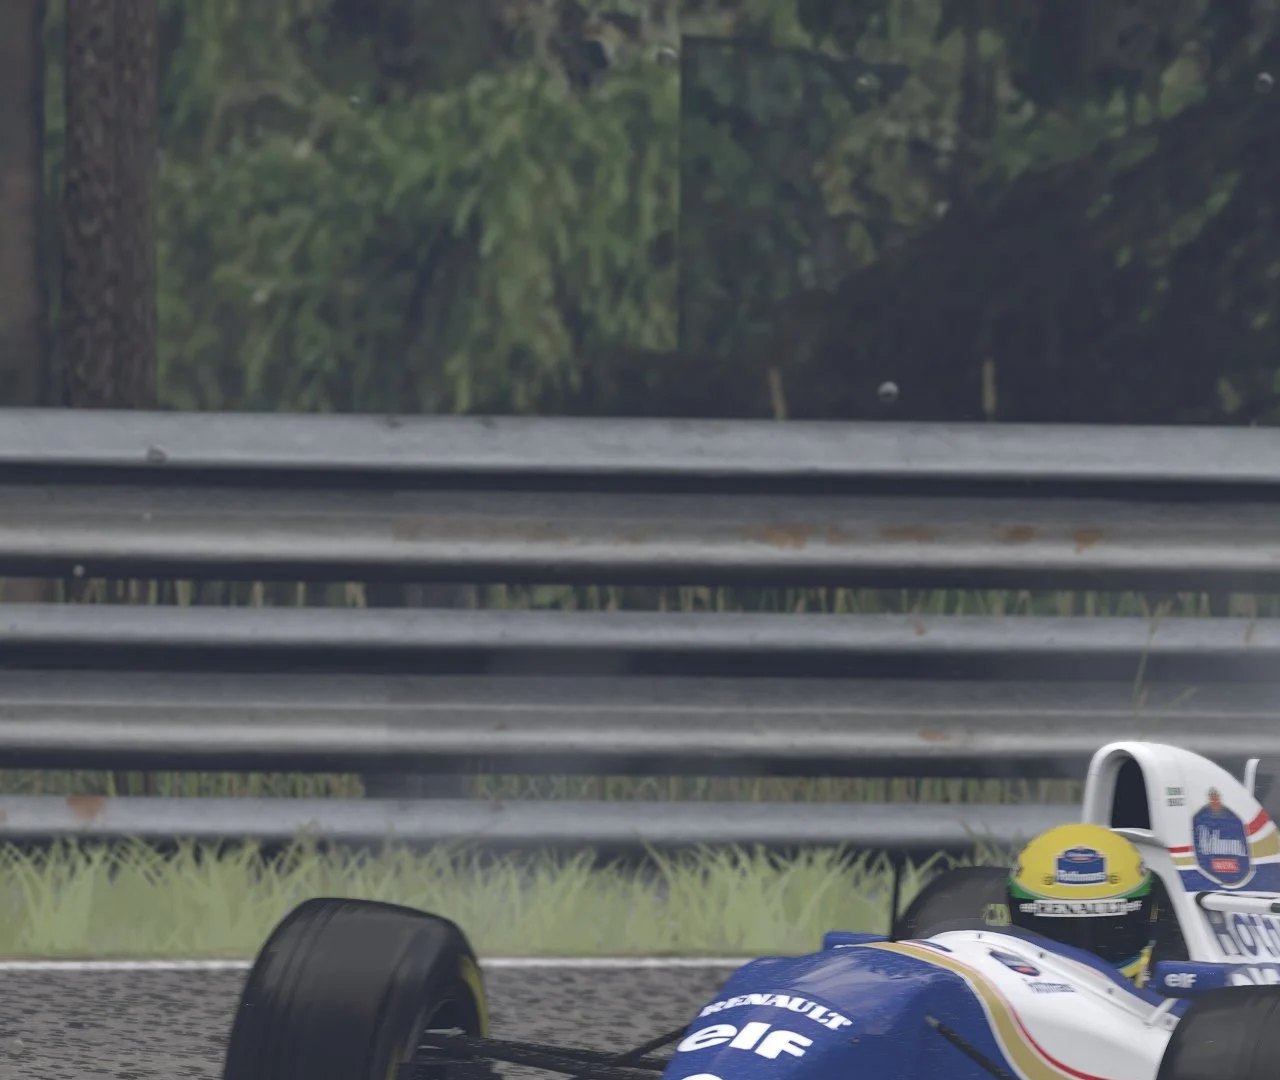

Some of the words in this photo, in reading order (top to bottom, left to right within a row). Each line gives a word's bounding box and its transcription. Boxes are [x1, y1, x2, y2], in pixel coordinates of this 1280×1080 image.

[1164, 972, 1198, 989] elf
[698, 993, 854, 1031] RENAULT
[676, 1021, 815, 1060] elf
